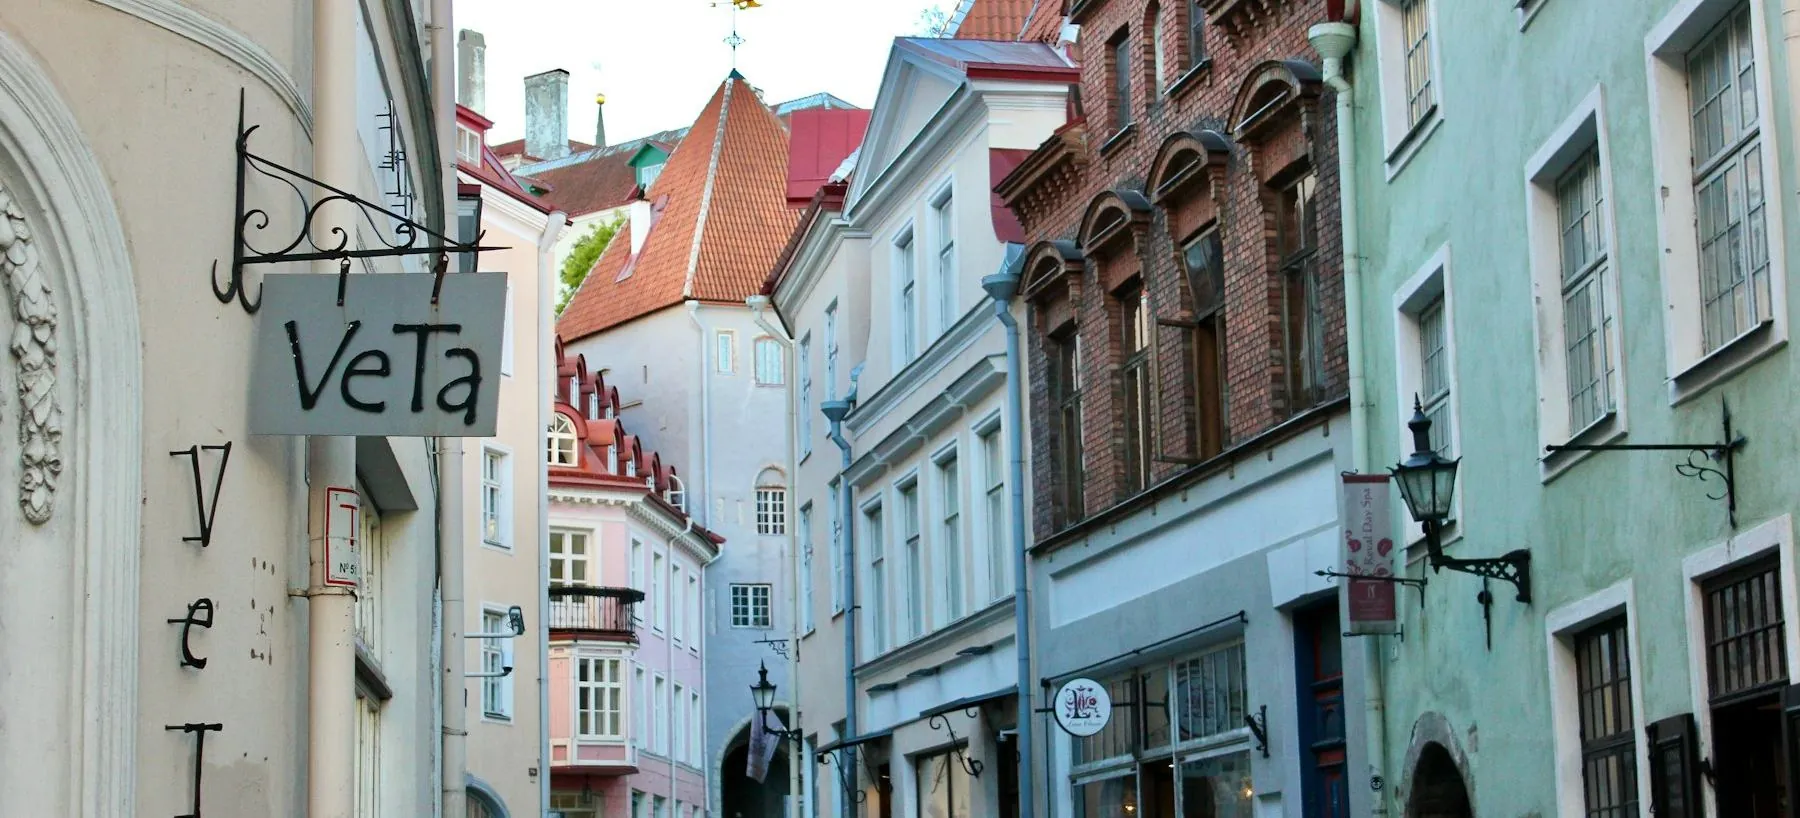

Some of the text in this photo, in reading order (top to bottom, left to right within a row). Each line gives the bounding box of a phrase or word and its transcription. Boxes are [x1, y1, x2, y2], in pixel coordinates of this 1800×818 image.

[284, 319, 483, 427] VeTa
[1362, 510, 1374, 533] Day
[1362, 535, 1374, 566] Royal
